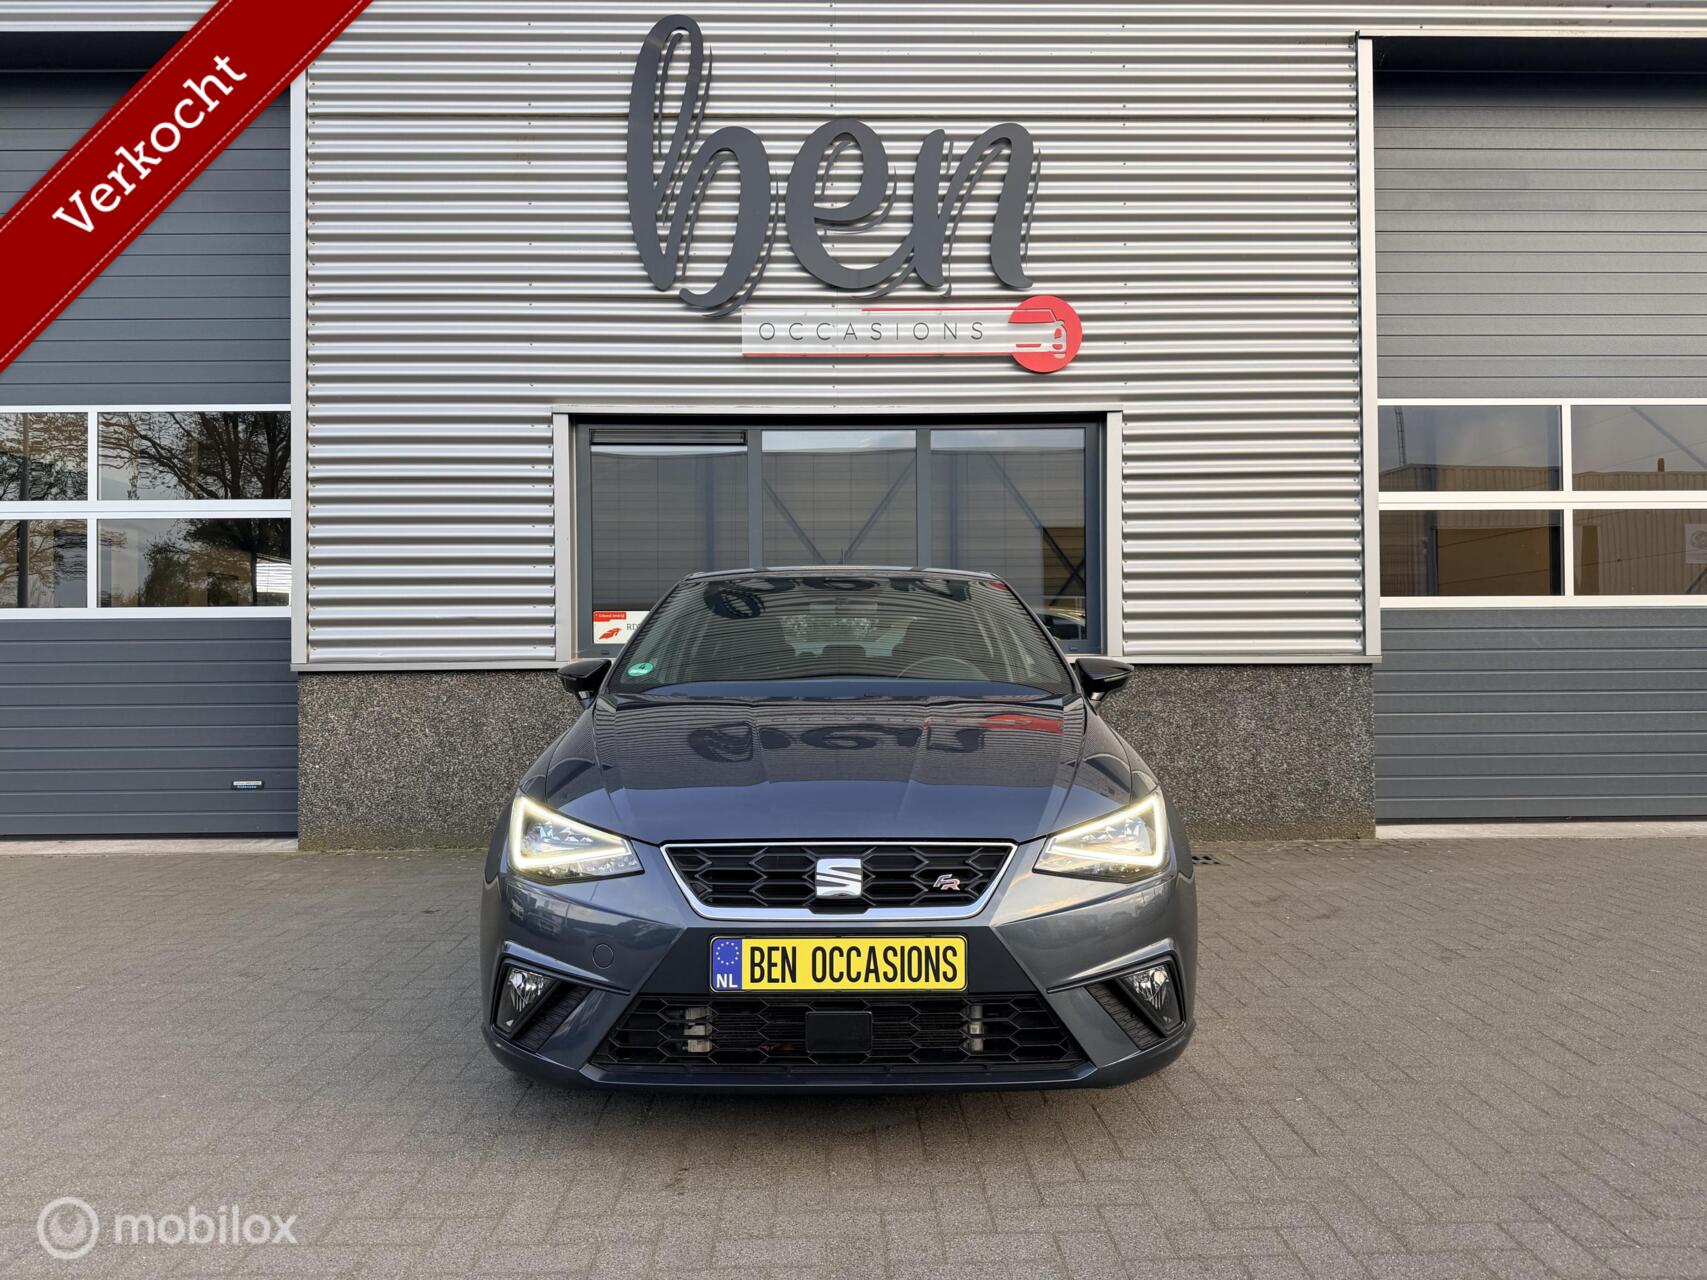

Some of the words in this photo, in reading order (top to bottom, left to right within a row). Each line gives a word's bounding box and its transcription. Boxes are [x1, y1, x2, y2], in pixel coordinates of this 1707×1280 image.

[627, 14, 1034, 308] ben
[758, 321, 984, 342] OCCASIONS
[932, 873, 960, 891] FR
[749, 945, 797, 984] BEN
[811, 945, 958, 984] OCCASIONS
[716, 973, 738, 989] NL
